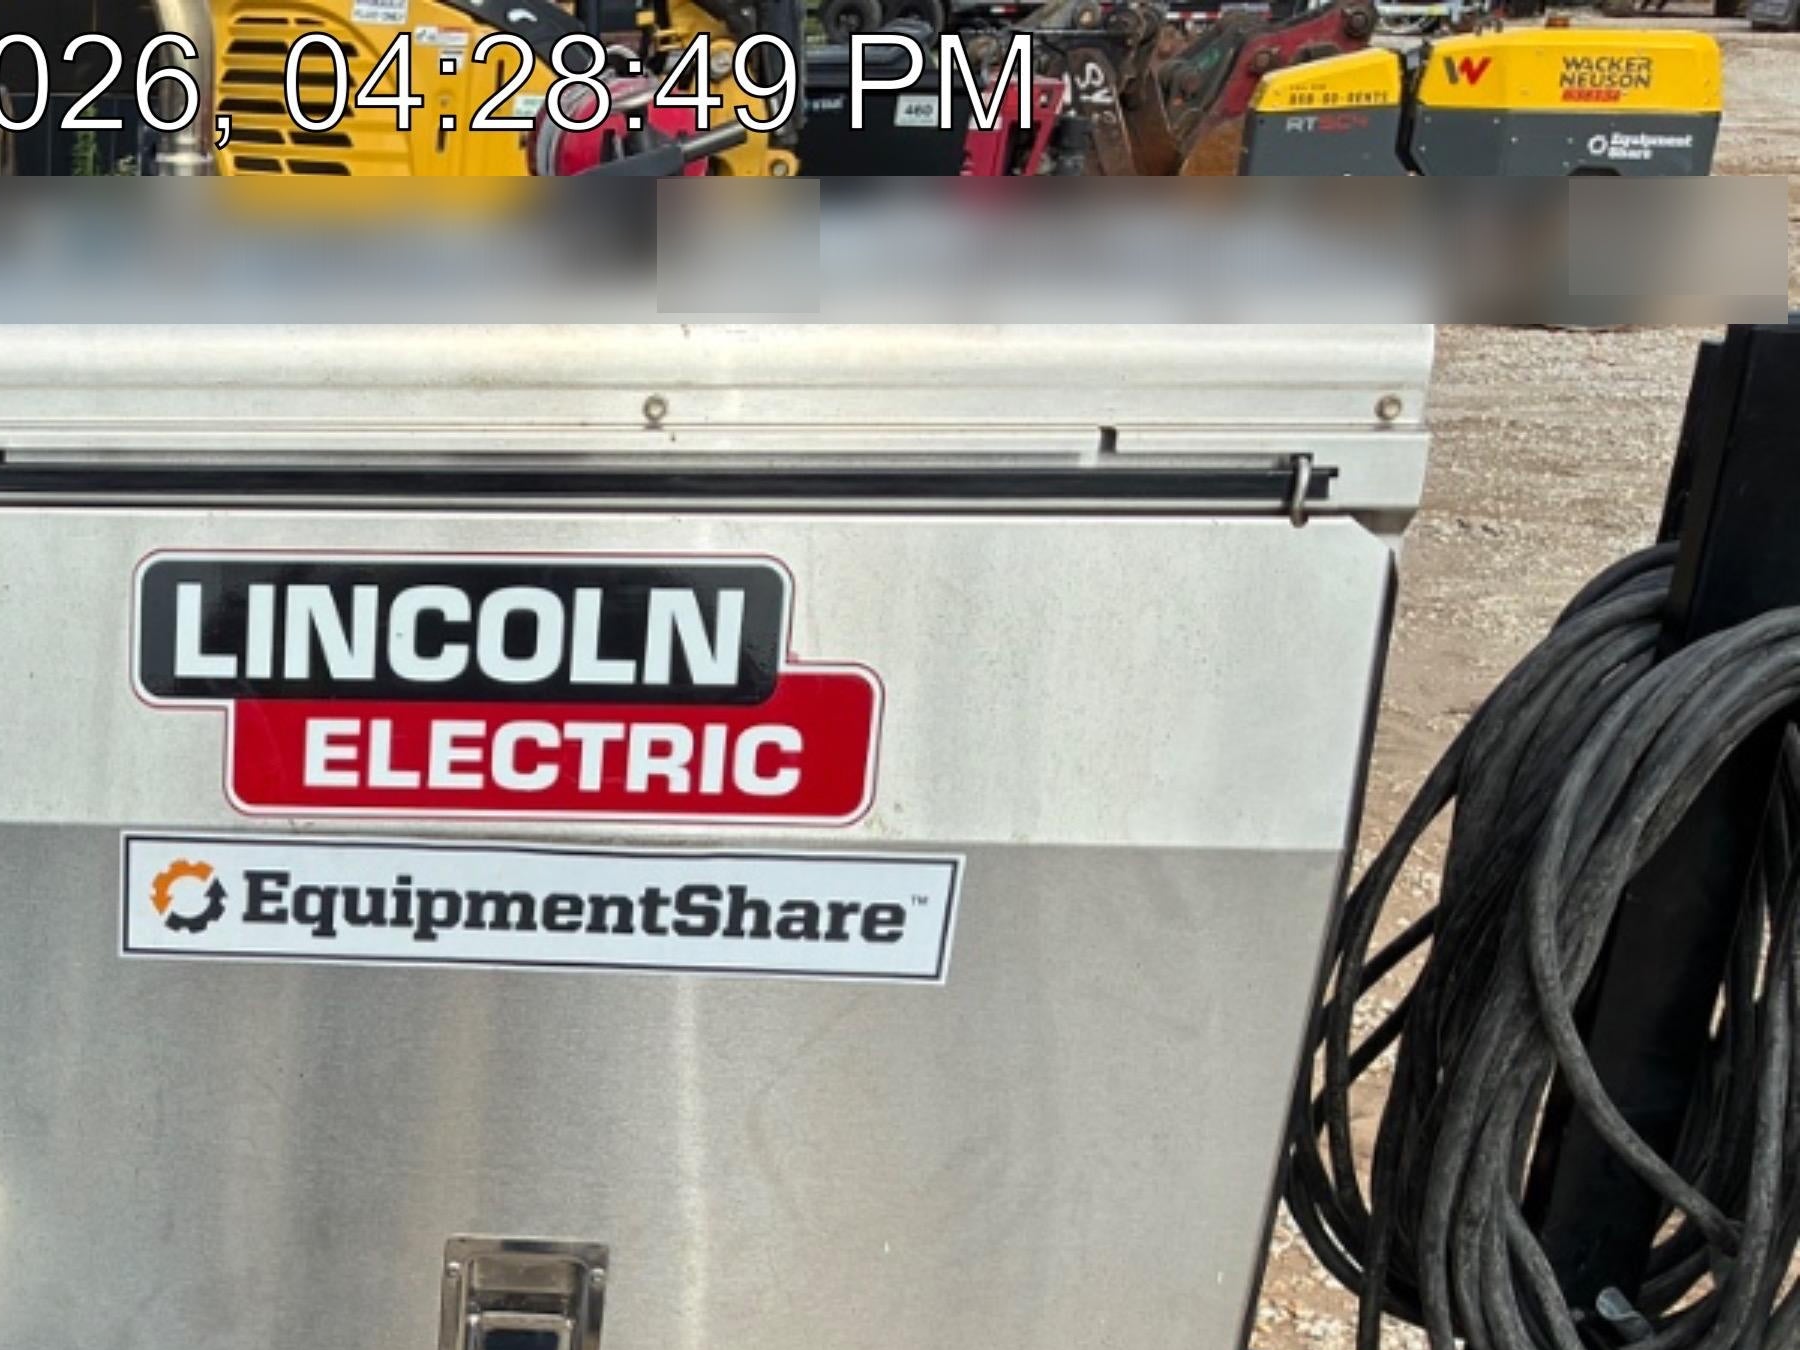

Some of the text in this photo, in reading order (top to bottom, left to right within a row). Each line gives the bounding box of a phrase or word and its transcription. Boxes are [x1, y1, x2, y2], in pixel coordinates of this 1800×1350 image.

[1563, 56, 1653, 71] WACKER
[1560, 73, 1651, 88] NEUSON
[1610, 132, 1693, 148] Equipment
[1608, 147, 1652, 160] Share
[174, 583, 745, 686] LINCOLN
[304, 718, 803, 796] ELECTRIC
[242, 870, 907, 942] EquipmentShare
